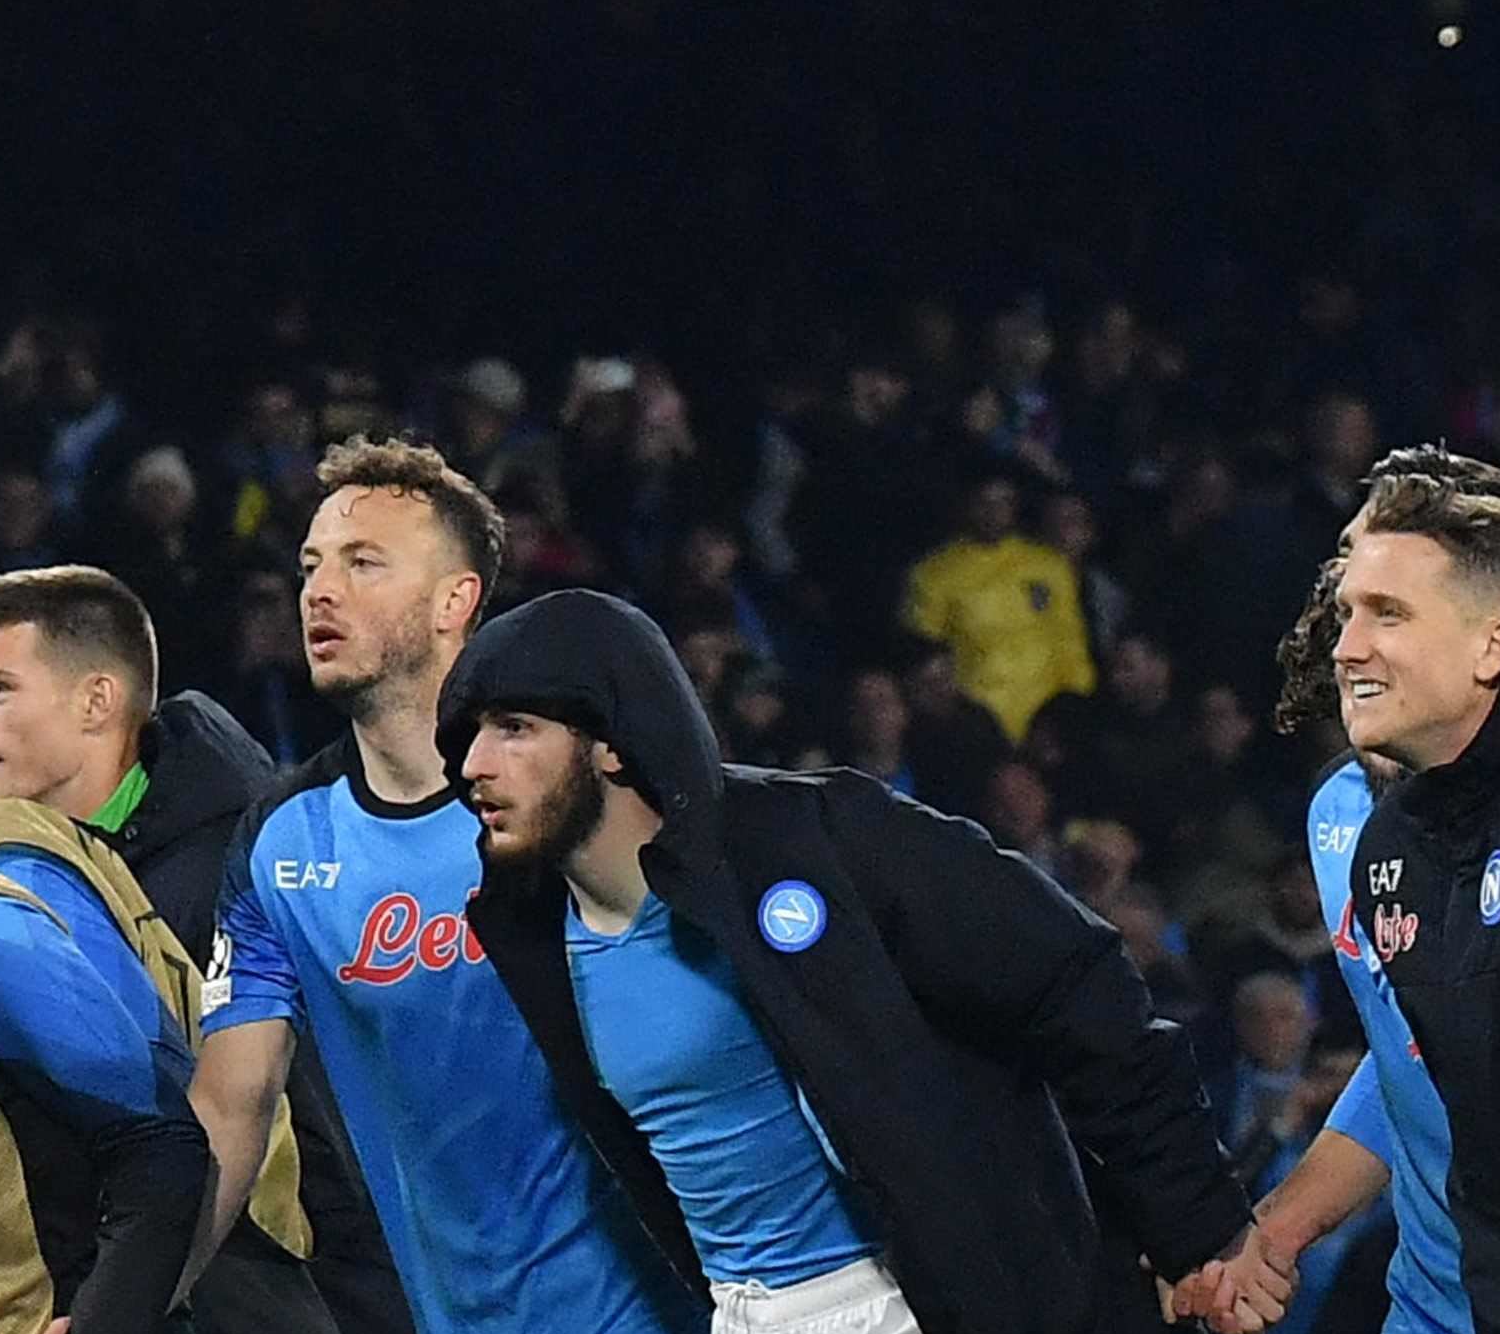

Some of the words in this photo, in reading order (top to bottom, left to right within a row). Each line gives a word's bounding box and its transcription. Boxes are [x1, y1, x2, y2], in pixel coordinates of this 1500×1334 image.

[1316, 822, 1357, 854] EA7
[274, 859, 342, 890] EA7
[1368, 858, 1404, 896] EA7
[337, 888, 488, 987] Le
